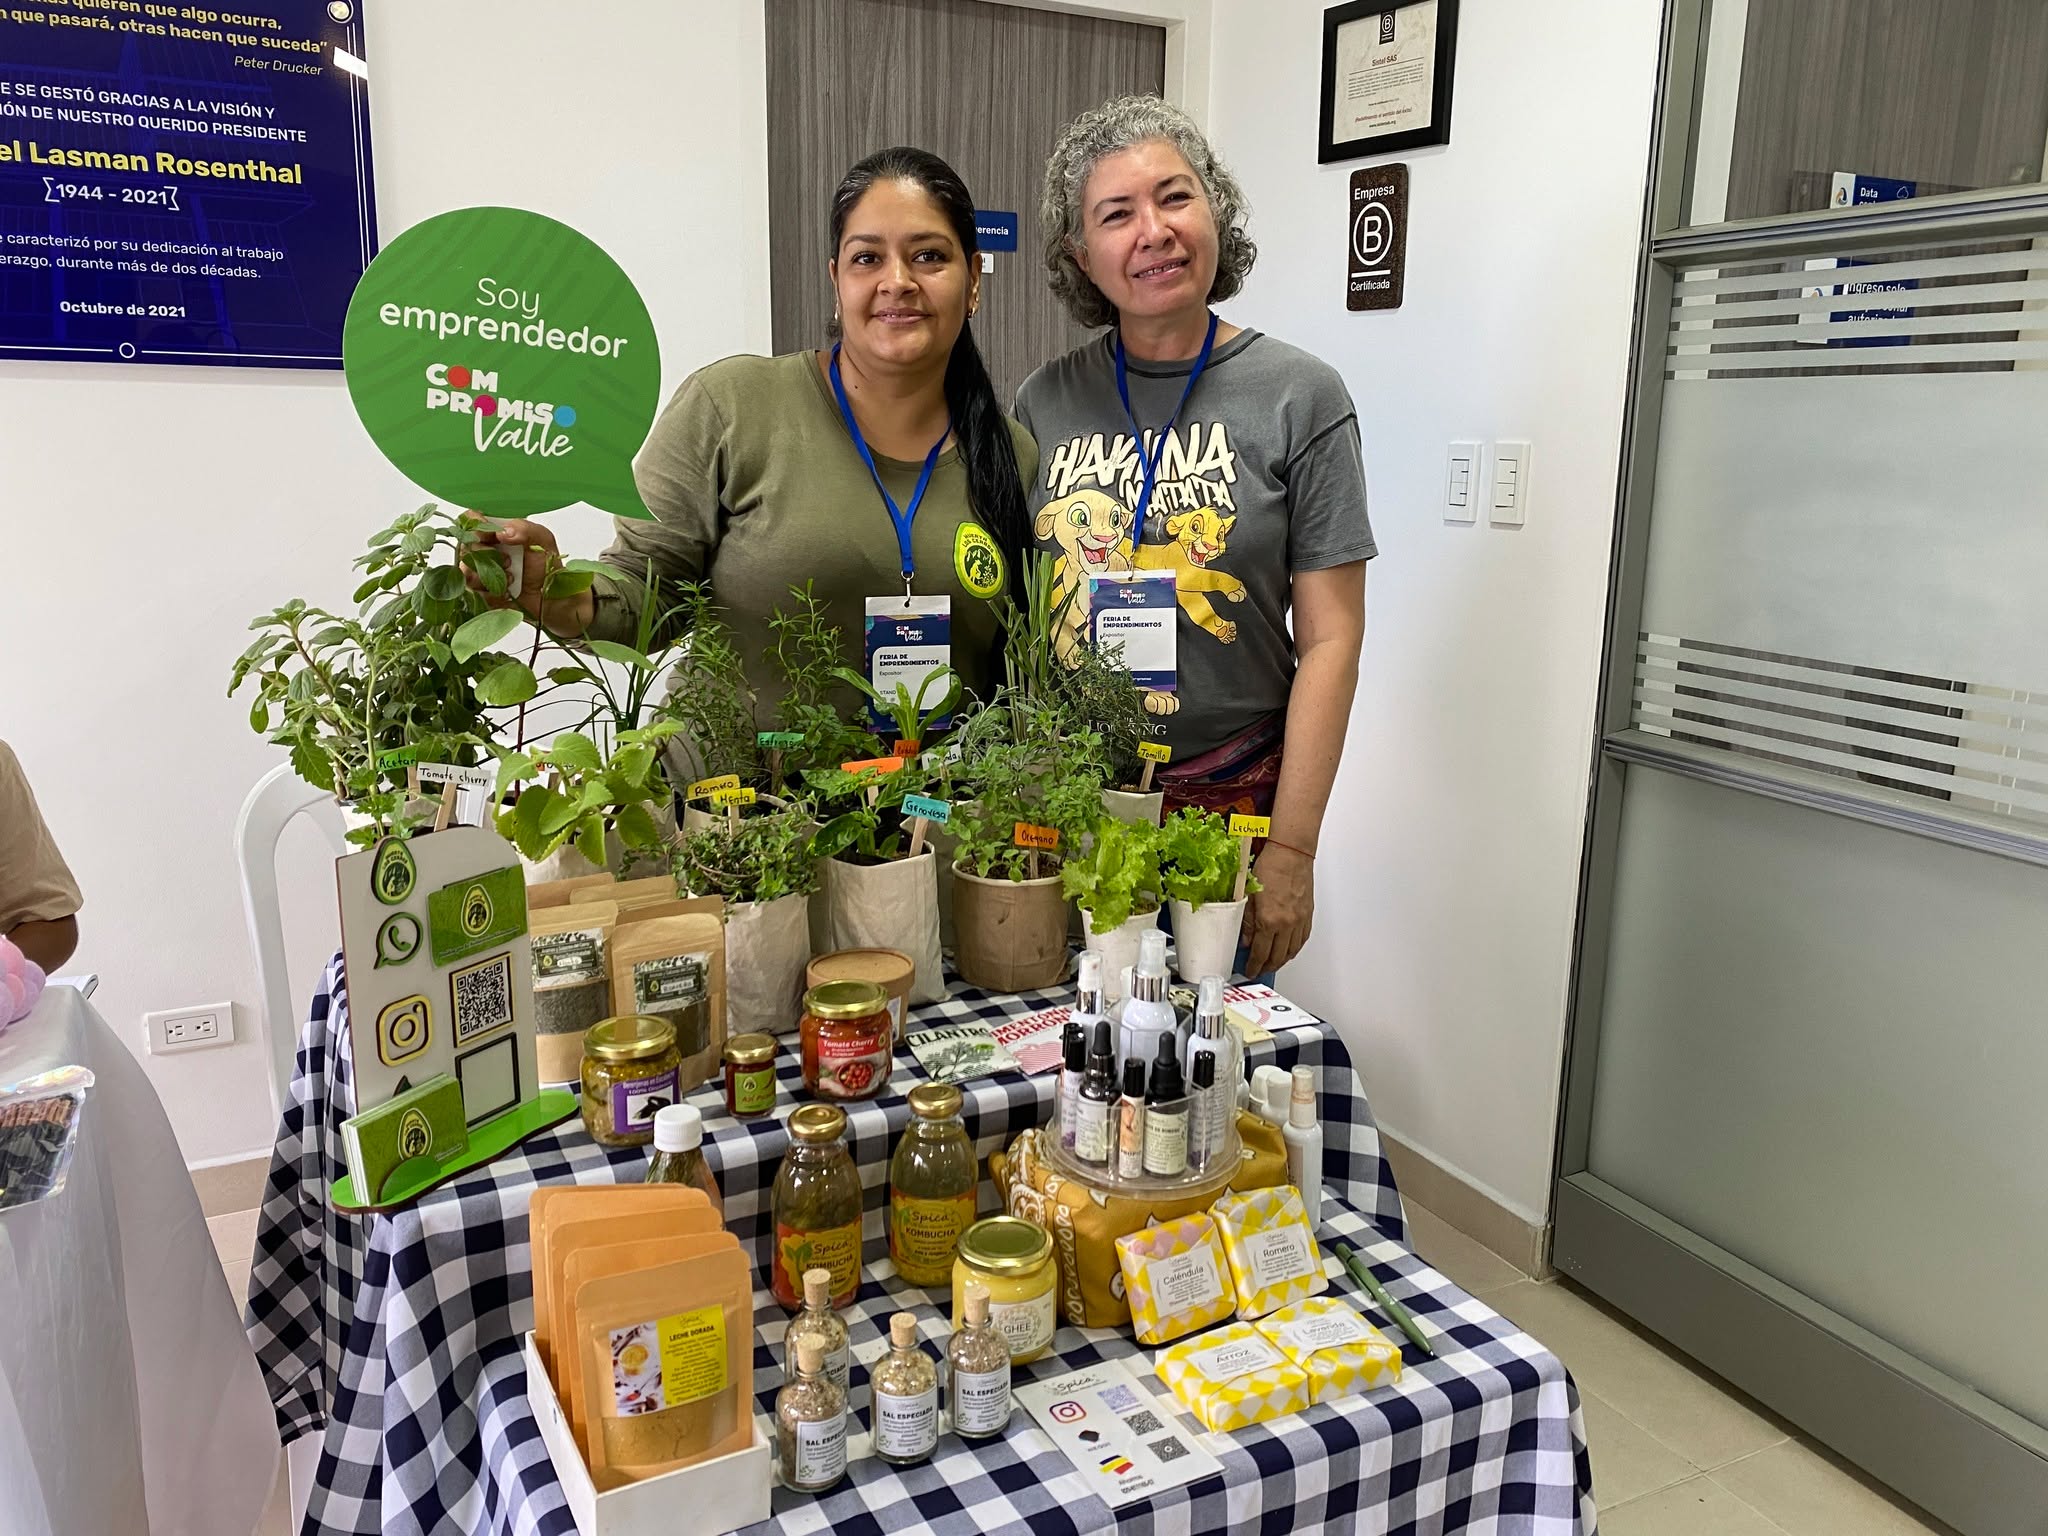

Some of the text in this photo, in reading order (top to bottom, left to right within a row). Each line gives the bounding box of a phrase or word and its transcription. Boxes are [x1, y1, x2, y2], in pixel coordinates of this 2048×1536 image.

[73, 0, 282, 30] quieren que algo ocurra,
[11, 12, 44, 23] que
[49, 14, 115, 31] pasará,
[119, 19, 166, 36] otras
[169, 24, 222, 42] hacen
[226, 33, 257, 46] que
[234, 55, 323, 75] Peter Drucker
[15, 83, 36, 97] SE
[40, 87, 94, 102] GESTÓ
[98, 91, 170, 109] GRACIAS
[173, 98, 184, 110] A
[187, 99, 208, 113] LA
[210, 102, 262, 118] VISIÓN
[264, 106, 275, 119] Y
[31, 106, 53, 119] DE
[57, 108, 134, 127] NUESTRO
[138, 116, 208, 134] QUERIDO
[212, 122, 307, 143] PRESIDENTE
[29, 141, 149, 172] Lasman
[156, 152, 302, 184] Rosenthal
[56, 183, 103, 201] 1944
[122, 188, 167, 205] 2021
[1354, 185, 1395, 201] Empresa
[1860, 187, 1879, 198] Data
[976, 226, 1009, 236] erencia
[1362, 215, 1382, 254] B
[7, 233, 90, 249] caracterizó
[94, 240, 118, 252] por
[121, 240, 138, 251] su
[142, 240, 218, 257] dedicación
[221, 246, 233, 257] al
[236, 246, 284, 262] trabajo
[56, 256, 113, 271] durante
[117, 261, 147, 272] más
[151, 262, 168, 274] de
[172, 264, 197, 275] dos
[200, 265, 262, 279] décadas.
[1351, 279, 1390, 292] Certificada
[476, 277, 540, 320] Soy
[59, 301, 186, 318] Octubre de 2021
[379, 302, 628, 358] emprendedor
[425, 363, 498, 393] COM
[474, 407, 573, 457] Valle
[1103, 621, 1162, 629] EMPRENDIMIENTOS
[1141, 748, 1166, 761] Tomillo
[419, 767, 487, 787] Tomate cherry
[695, 781, 734, 796] Romero
[906, 800, 946, 820] Genovesa
[1233, 819, 1265, 837] Lechuga
[1021, 830, 1054, 846] Oregano
[823, 1038, 874, 1048] Tomate Cherry
[906, 1027, 988, 1047] CILANTRO
[905, 1227, 955, 1238] KOMBUCHA
[1263, 1244, 1295, 1257] Romero
[806, 1254, 852, 1269] KOMBUCHA
[1163, 1265, 1204, 1285] Caléndula
[669, 1325, 715, 1343] LECHE DORADA
[1004, 1323, 1031, 1334] GHEE
[962, 1388, 975, 1396] SAL
[883, 1406, 933, 1419] SAL ESPECIADA
